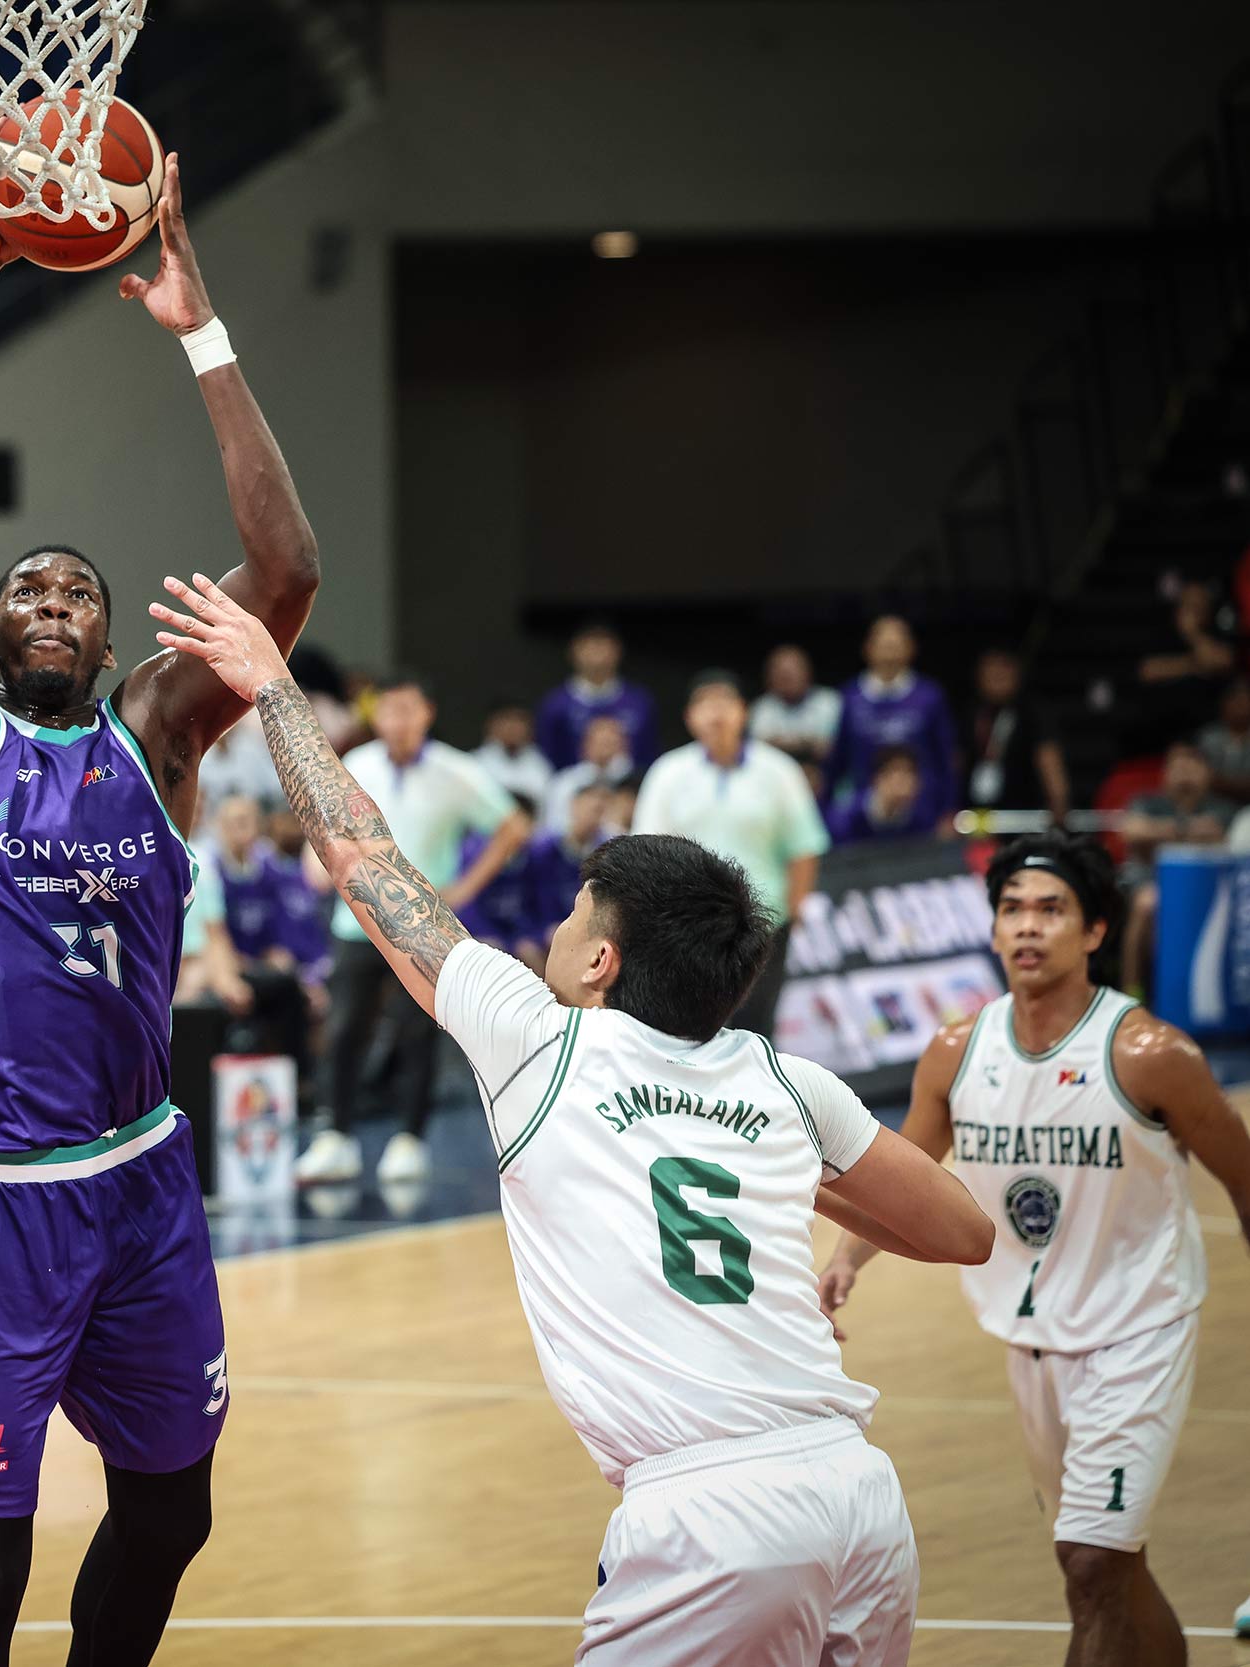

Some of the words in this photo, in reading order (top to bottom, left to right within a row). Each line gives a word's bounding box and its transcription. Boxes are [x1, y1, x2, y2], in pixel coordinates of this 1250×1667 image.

[50, 921, 124, 991] 31
[595, 1083, 770, 1144] SANGALANG
[649, 1157, 754, 1305] 6
[1105, 1467, 1126, 1511] 1
